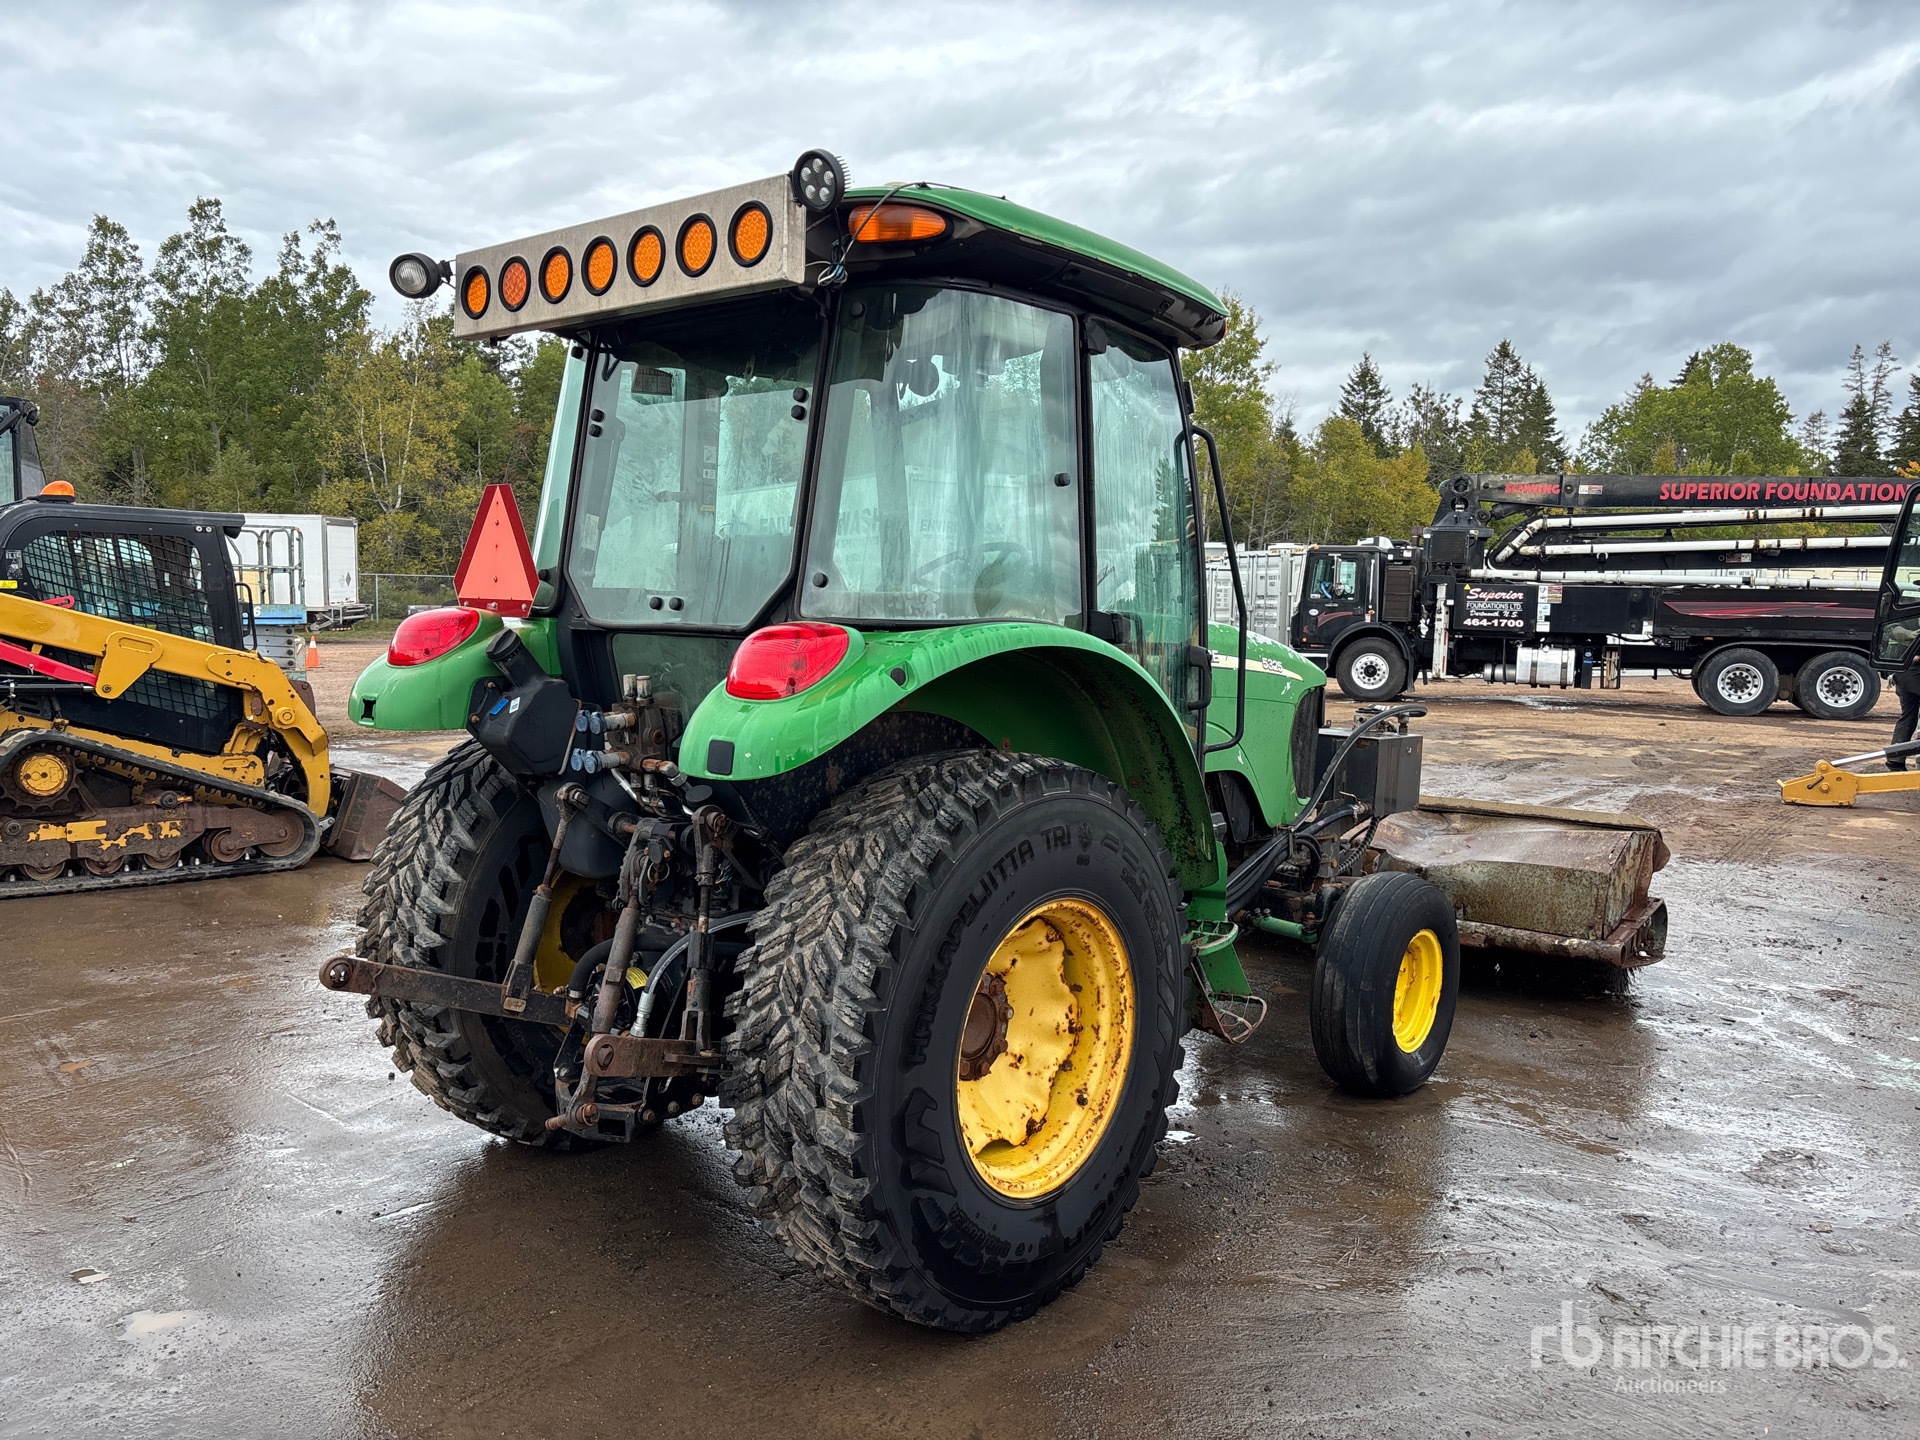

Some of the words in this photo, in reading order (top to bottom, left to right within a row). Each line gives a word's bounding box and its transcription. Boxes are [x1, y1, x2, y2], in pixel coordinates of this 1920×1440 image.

[1660, 482, 1760, 500] SUPERIOR
[1764, 482, 1920, 501] FOUNDATION
[1466, 588, 1524, 602] Superior
[1466, 602, 1509, 610] FOUNDATIONS
[1463, 618, 1524, 627] 464-1700
[1261, 657, 1284, 673] 5325
[1040, 824, 1072, 851] TRI
